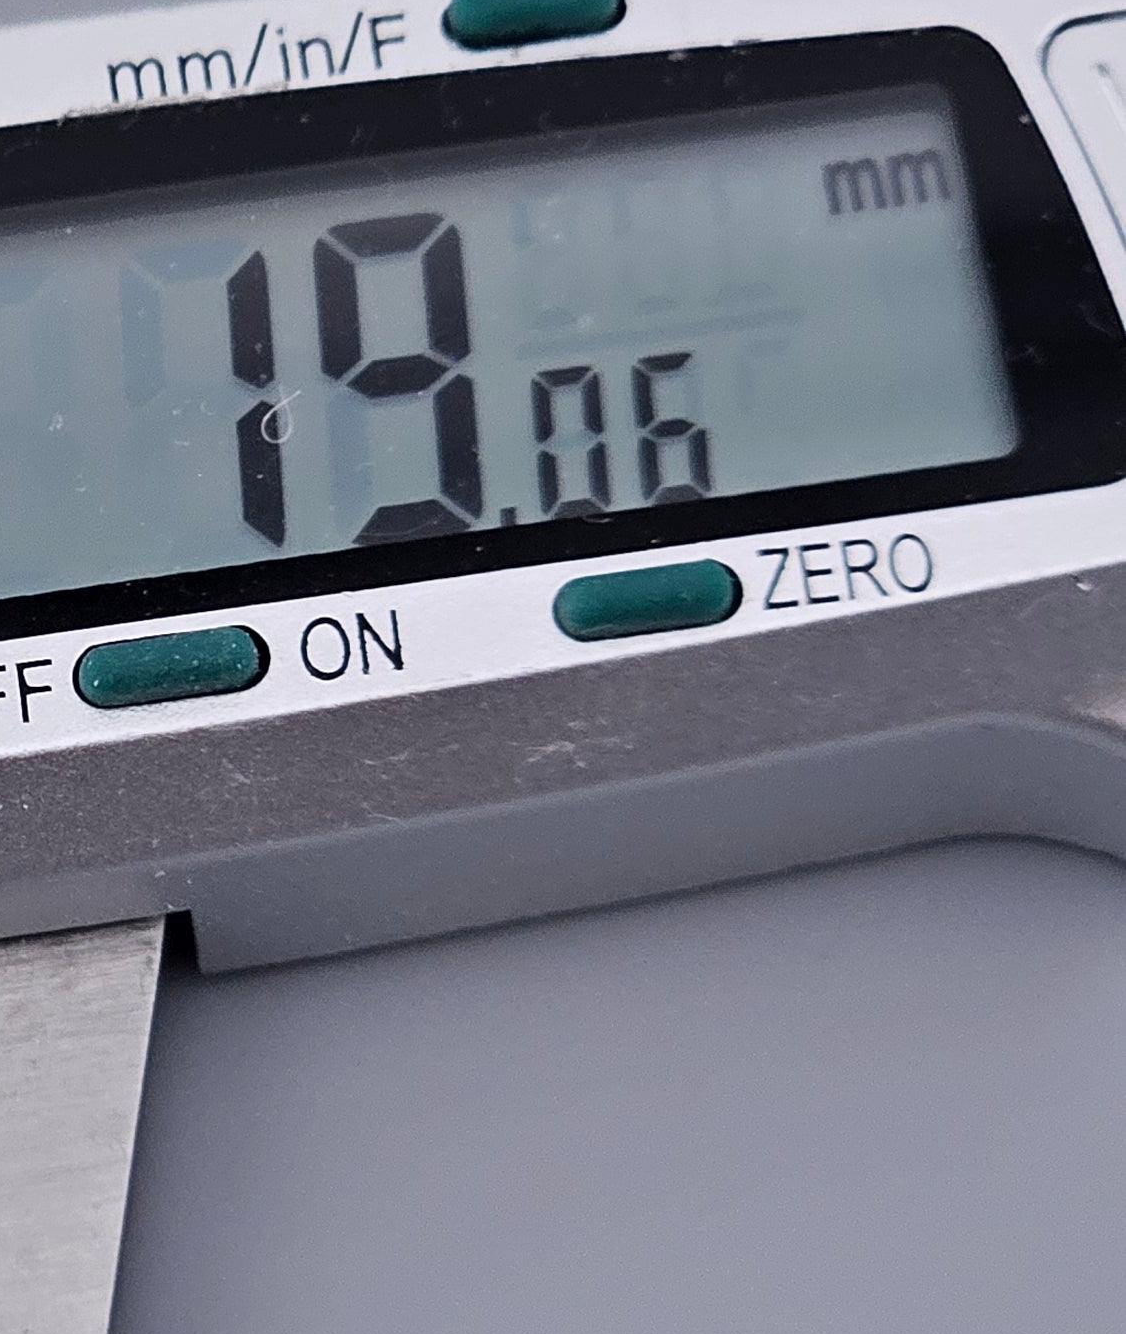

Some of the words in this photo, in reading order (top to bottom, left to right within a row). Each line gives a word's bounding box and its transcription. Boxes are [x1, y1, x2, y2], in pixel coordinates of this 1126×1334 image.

[106, 10, 409, 104] mm/in/F
[822, 147, 951, 216] mm
[756, 533, 934, 610] ZERO
[300, 609, 406, 682] ON
